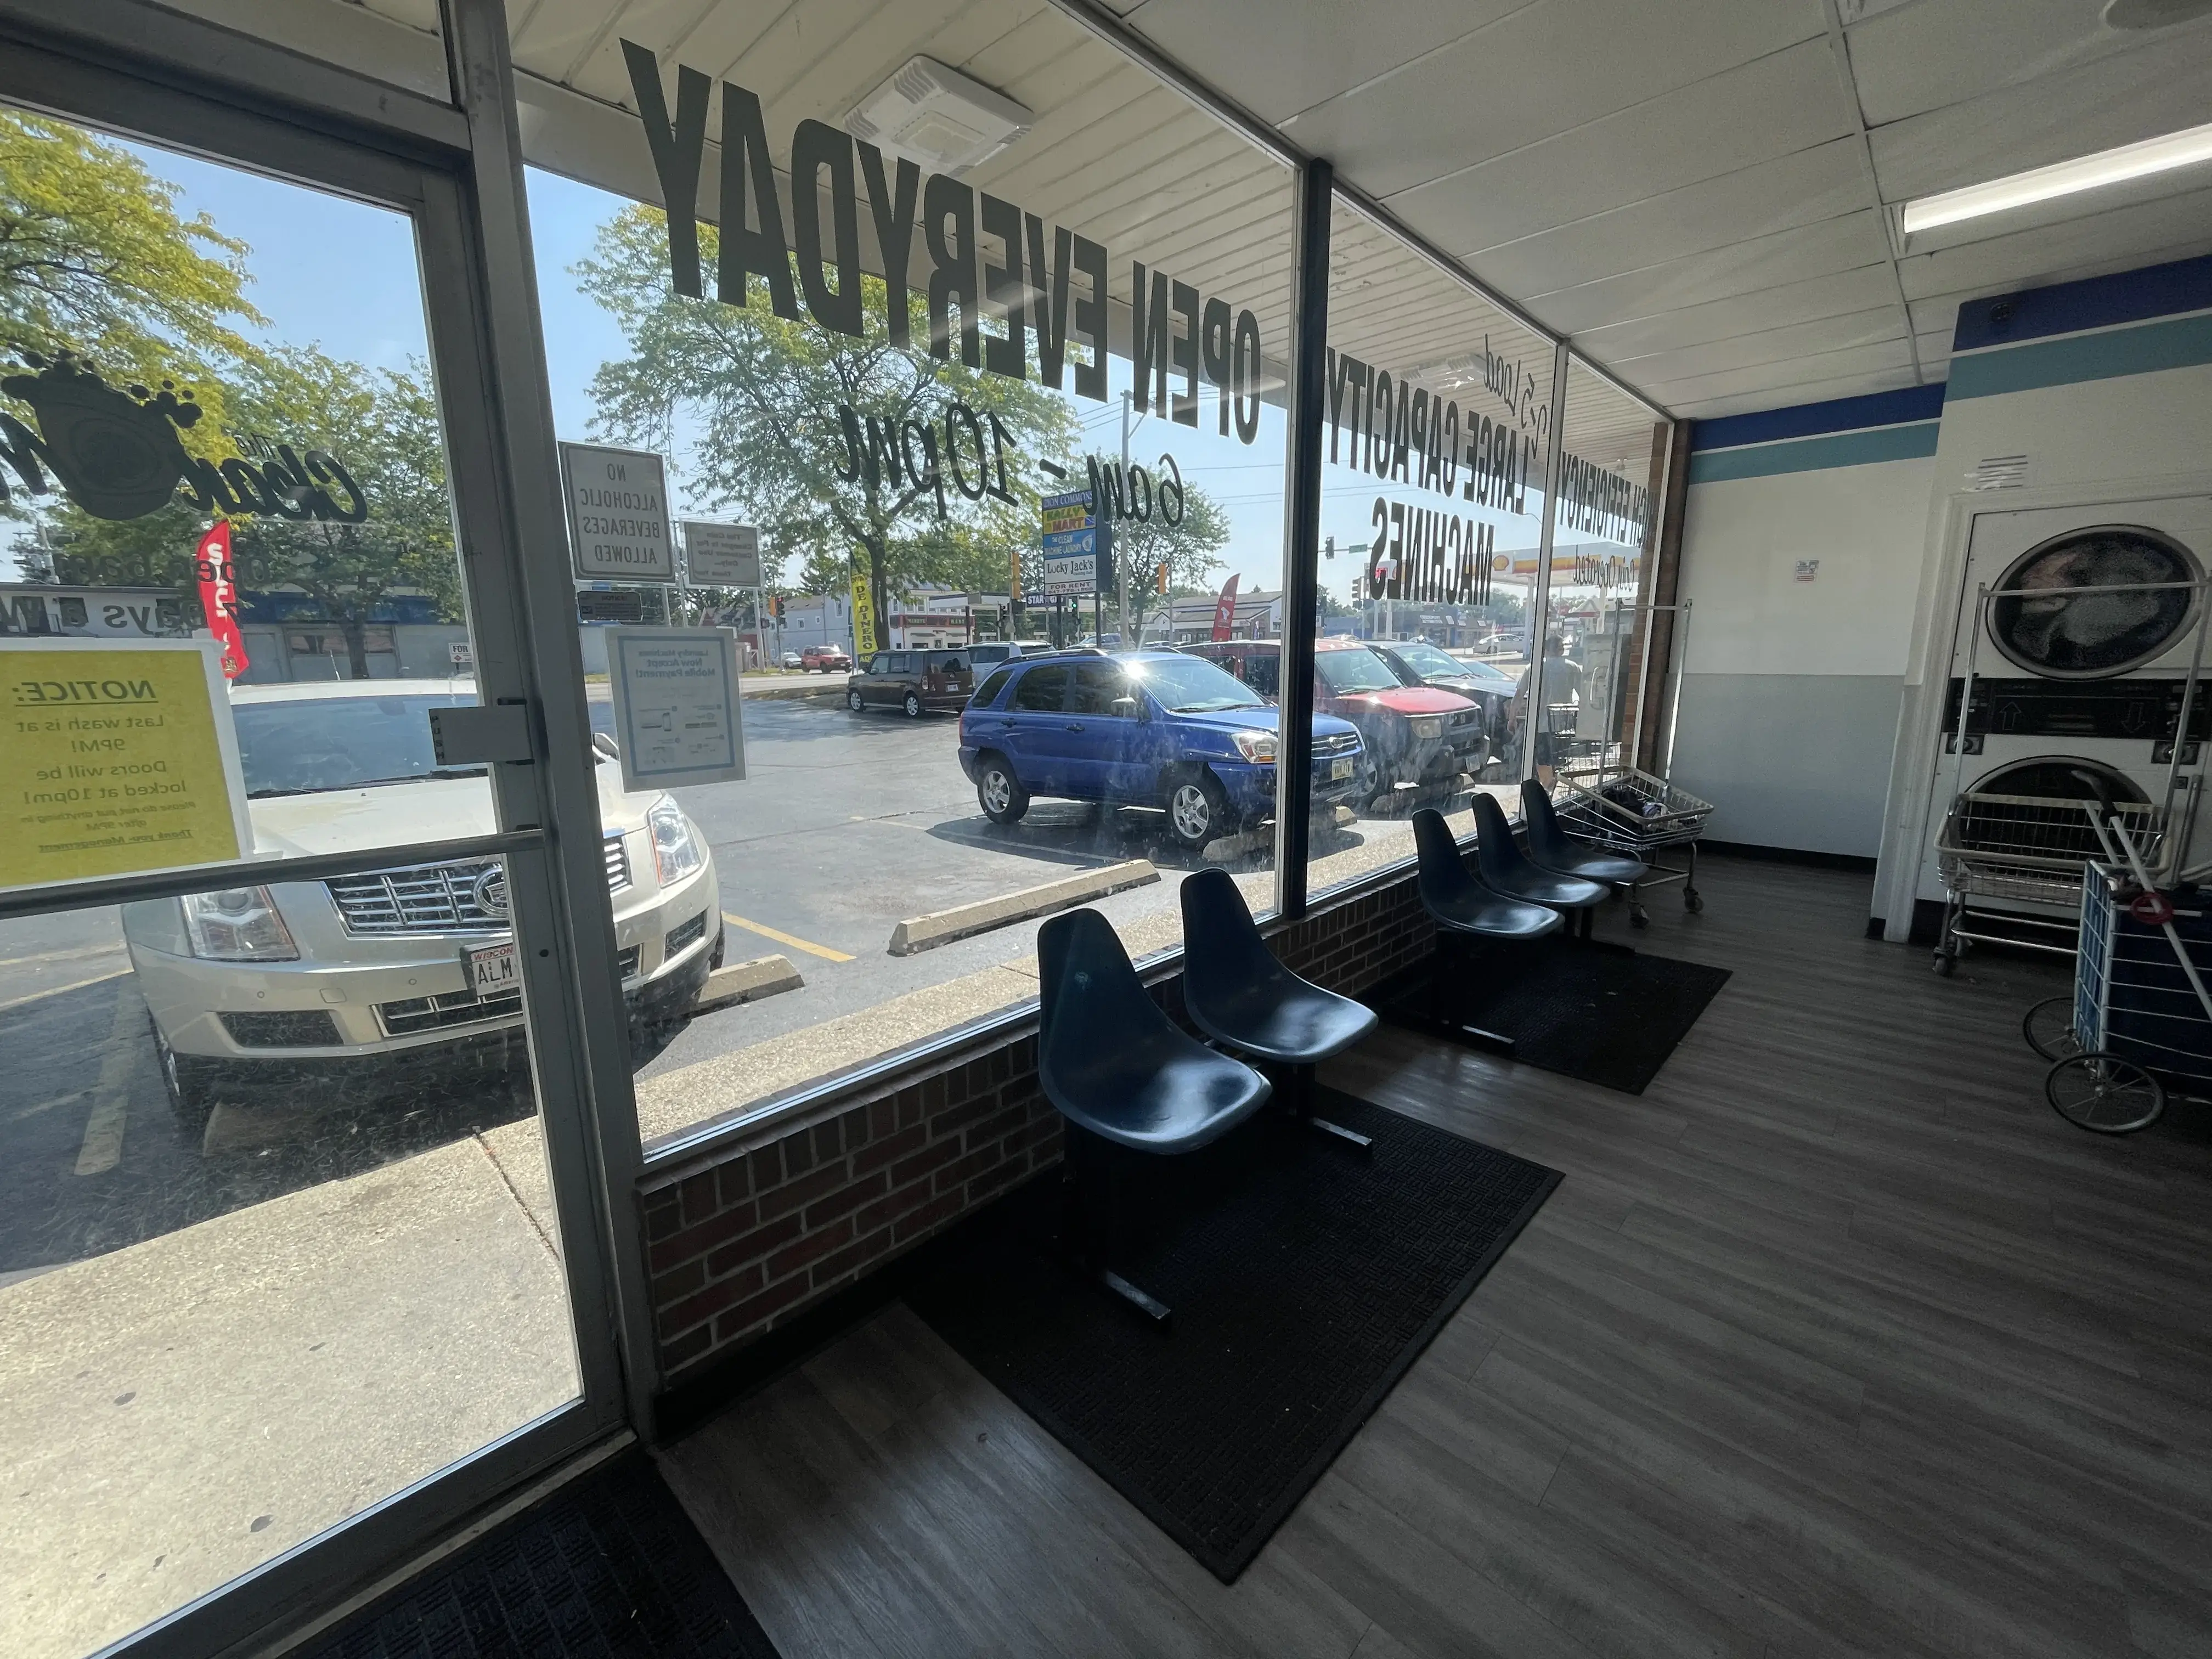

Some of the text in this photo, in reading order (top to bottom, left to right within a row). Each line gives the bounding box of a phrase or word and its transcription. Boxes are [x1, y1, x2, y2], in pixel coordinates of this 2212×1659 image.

[1047, 559, 1094, 575] Lucky Jack's
[859, 605, 872, 650] DINERO
[473, 946, 514, 961] WISCON
